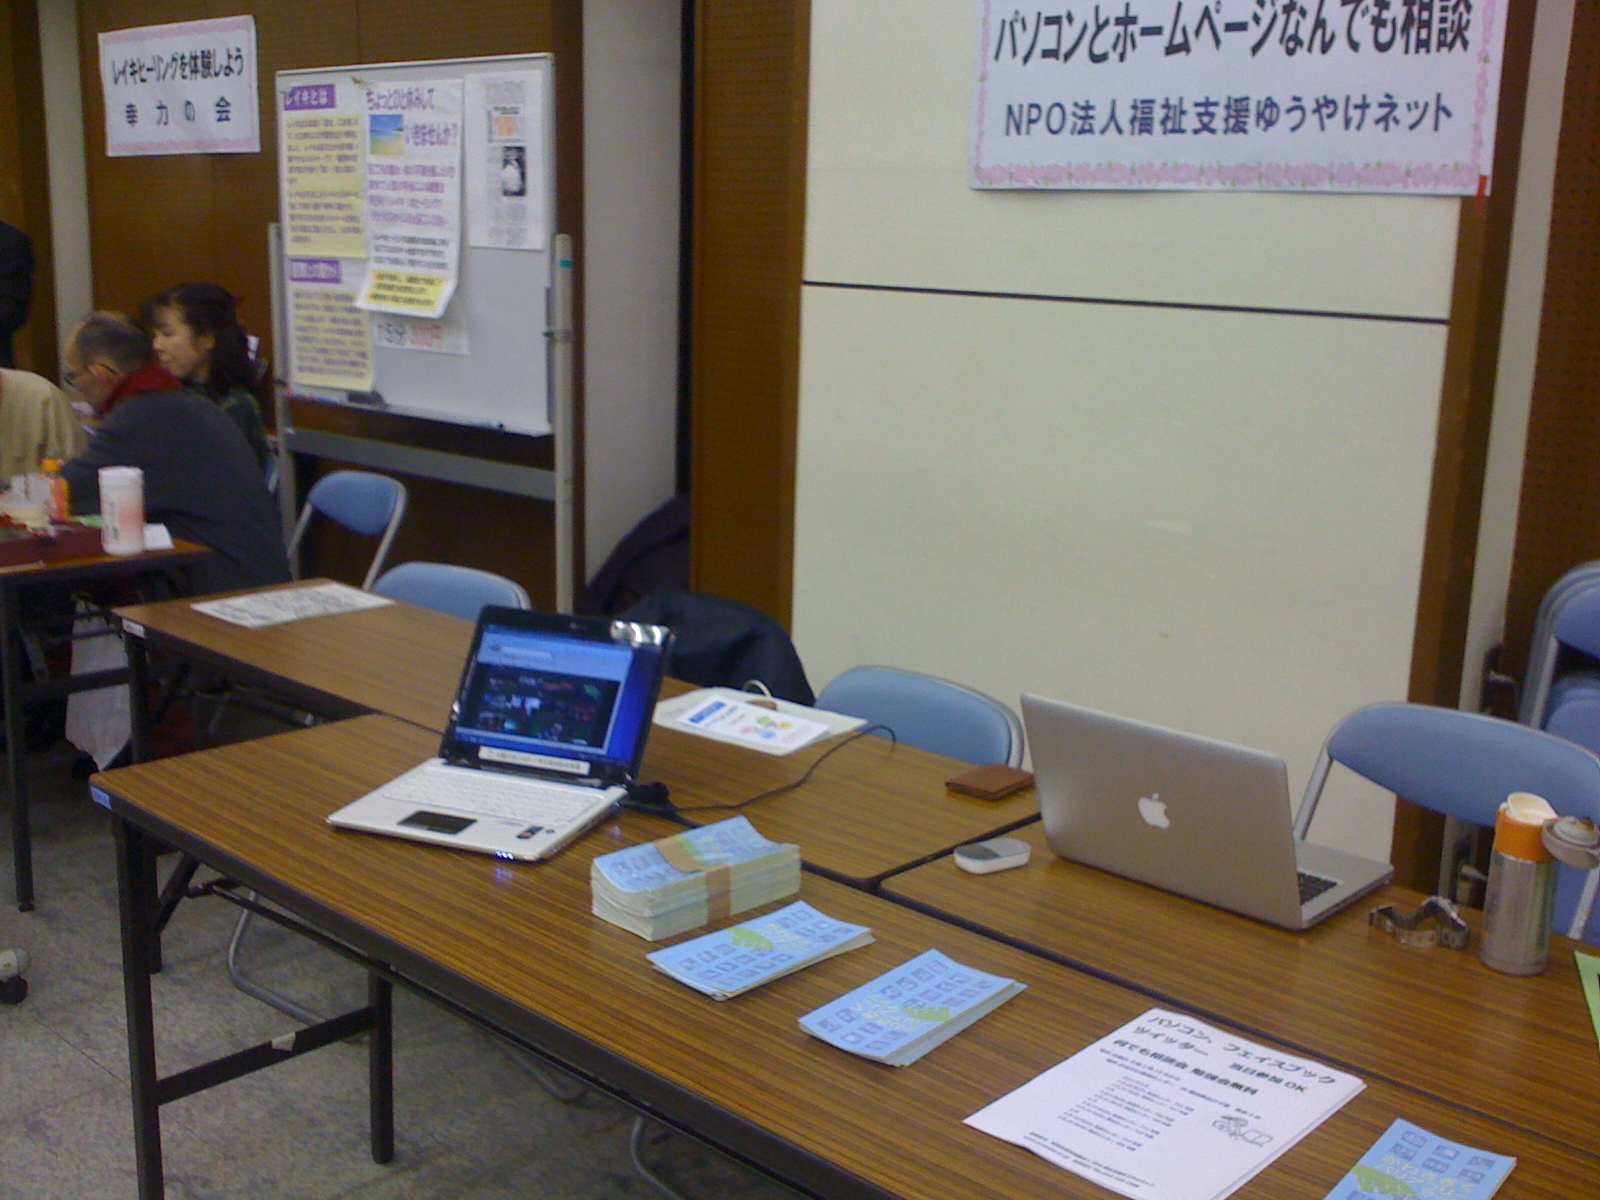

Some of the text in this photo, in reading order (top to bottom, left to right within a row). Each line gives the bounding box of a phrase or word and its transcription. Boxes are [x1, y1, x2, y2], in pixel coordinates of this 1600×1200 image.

[994, 0, 1474, 66] パソコンとホームページなんでも相談
[112, 47, 244, 86] レイキヒーリングを体験しよう
[1005, 92, 1454, 137] NPO法人福祉支援ゆうやけネット
